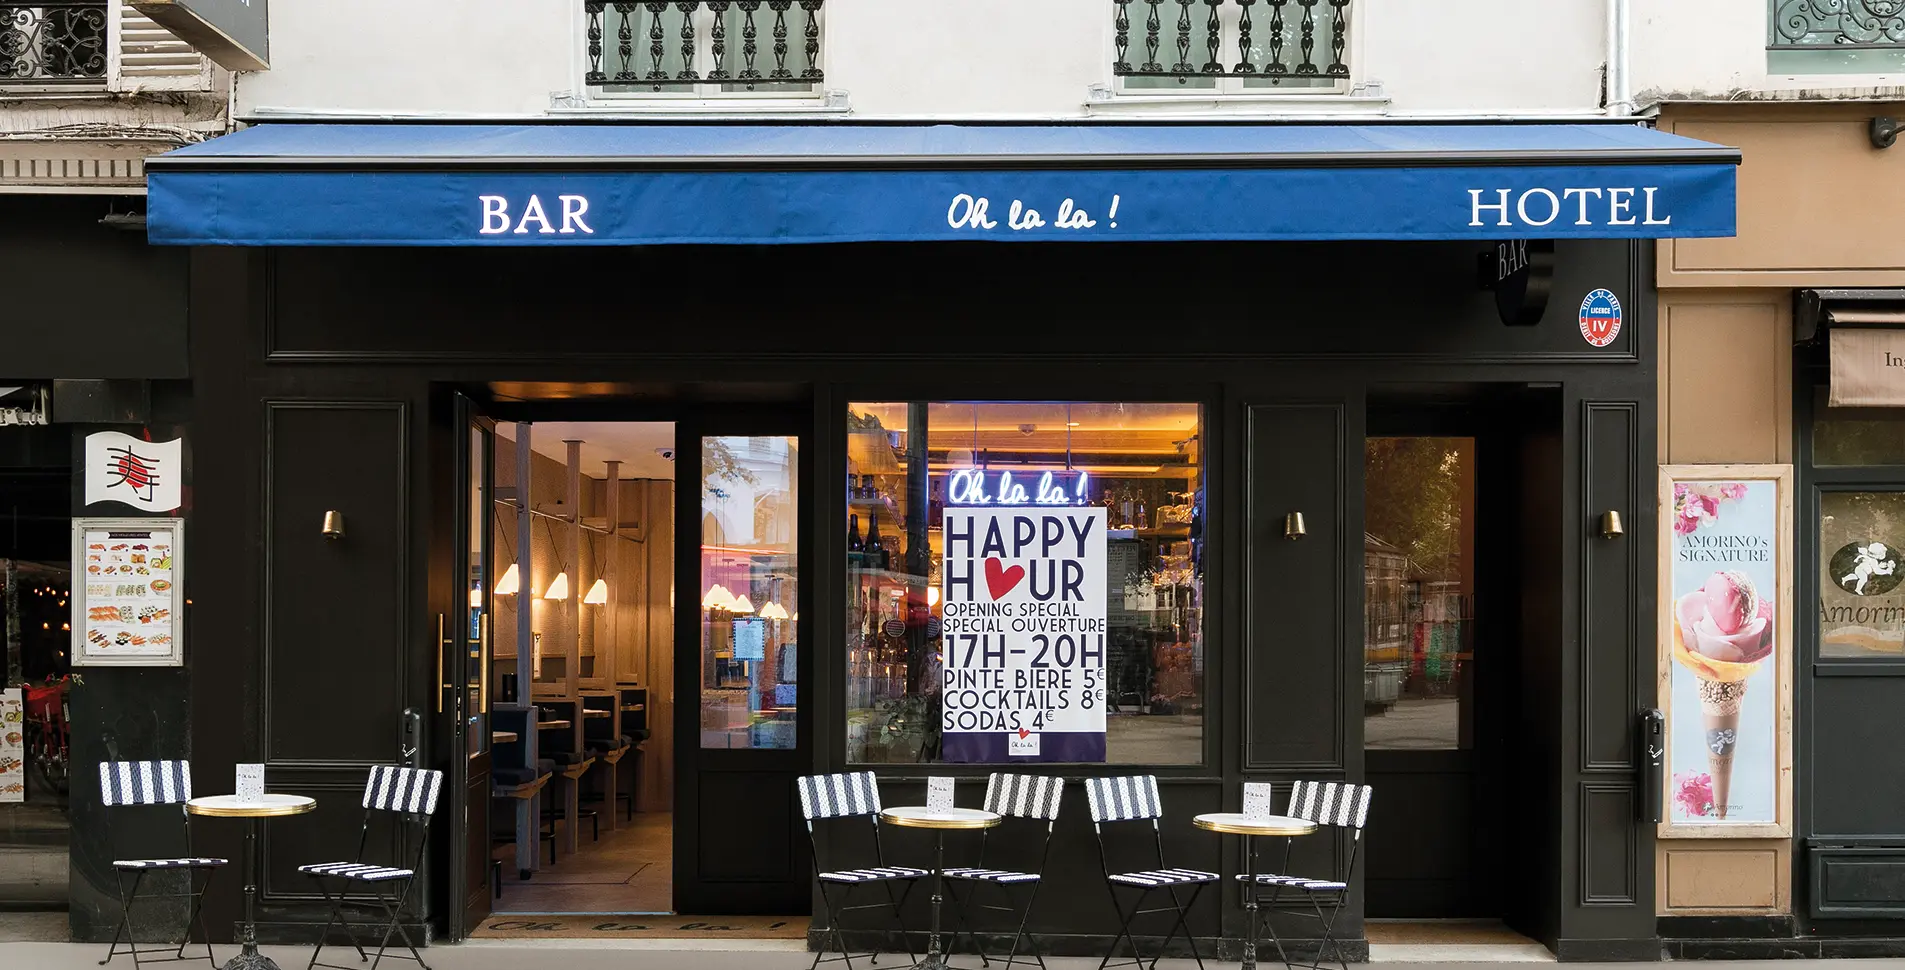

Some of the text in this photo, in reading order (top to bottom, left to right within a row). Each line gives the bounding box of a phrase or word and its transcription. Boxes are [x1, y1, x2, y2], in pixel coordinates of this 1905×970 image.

[478, 194, 594, 234] BAR
[947, 193, 1121, 230] Oh la la !
[1467, 187, 1672, 226] HOTEL
[1499, 239, 1528, 281] BAR
[1590, 307, 1611, 315] LICENCE
[1592, 320, 1608, 332] IV
[950, 471, 1088, 505] Oh la la !
[946, 516, 1096, 558] HAPPY
[1682, 535, 1768, 548] AMORINO's
[1679, 549, 1768, 562] SIGNATURE
[944, 603, 1080, 617] OPENING SPECIAL
[944, 618, 1004, 632] SPECIAL
[1012, 618, 1105, 632] OUVERTURE
[945, 634, 1104, 668] 17H-20H
[944, 668, 1105, 689] PINTE BIERE 5€
[944, 689, 1104, 710] COCKTAILS 8€
[944, 709, 1055, 731] SODAS 4€
[488, 921, 570, 931] Oh
[591, 922, 656, 931] la
[676, 922, 744, 931] la
